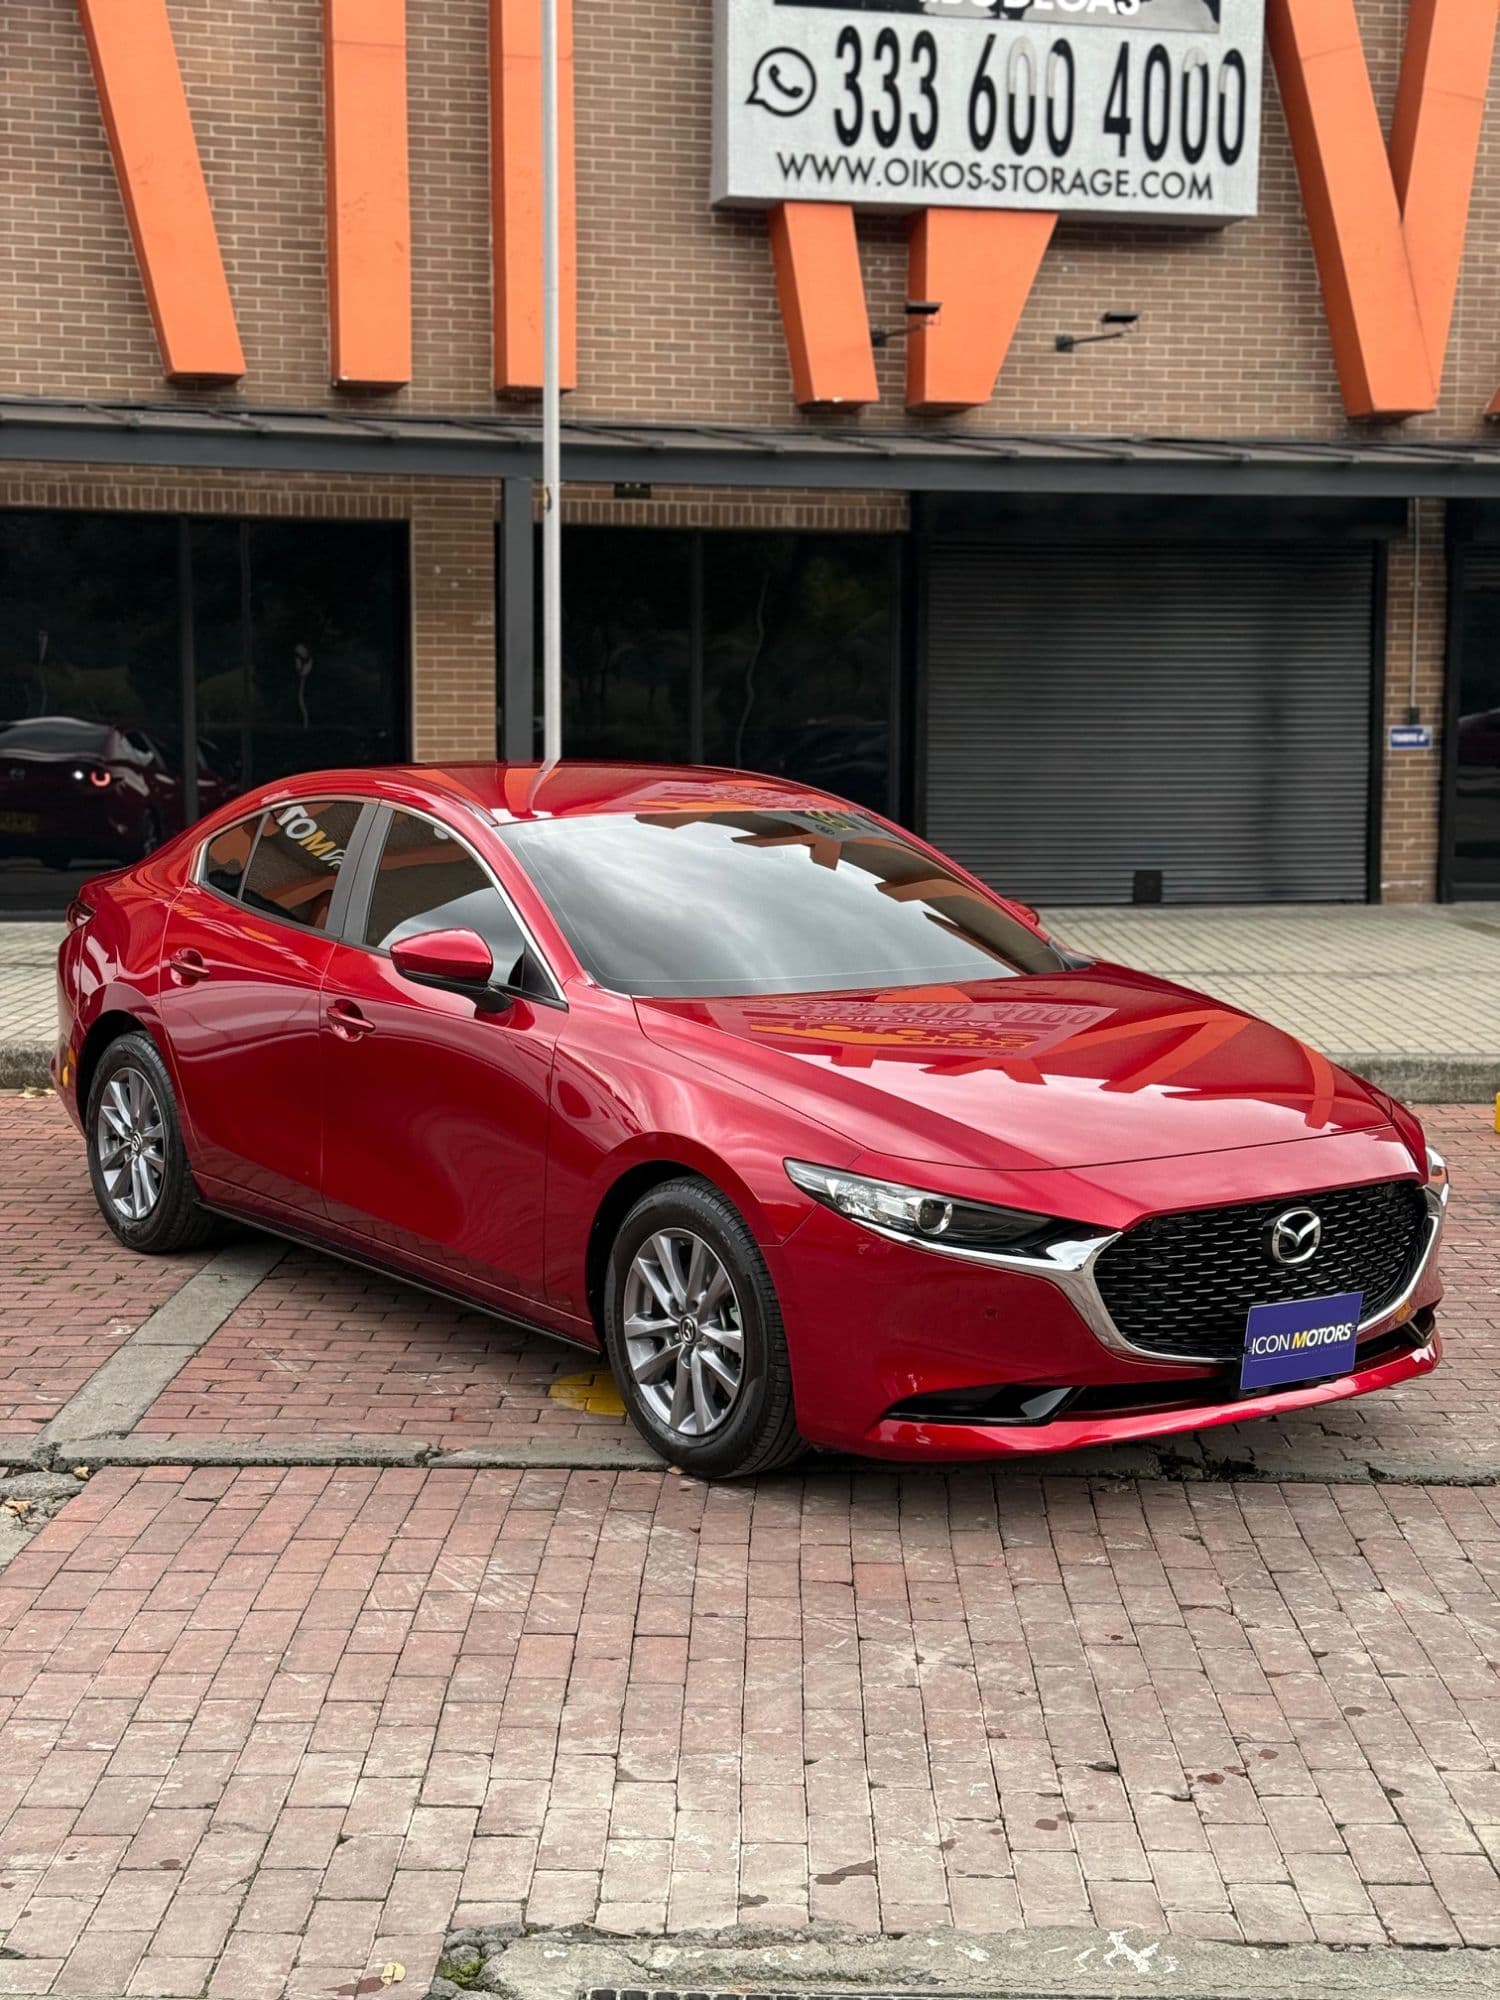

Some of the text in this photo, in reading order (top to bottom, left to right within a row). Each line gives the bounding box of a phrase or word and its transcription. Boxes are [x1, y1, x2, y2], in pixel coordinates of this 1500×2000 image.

[834, 25, 1247, 166] 333 600 4000
[775, 152, 1214, 201] WWW.OIKOS-STORAGE.COM
[1251, 1323, 1352, 1355] ICON MOTORS
